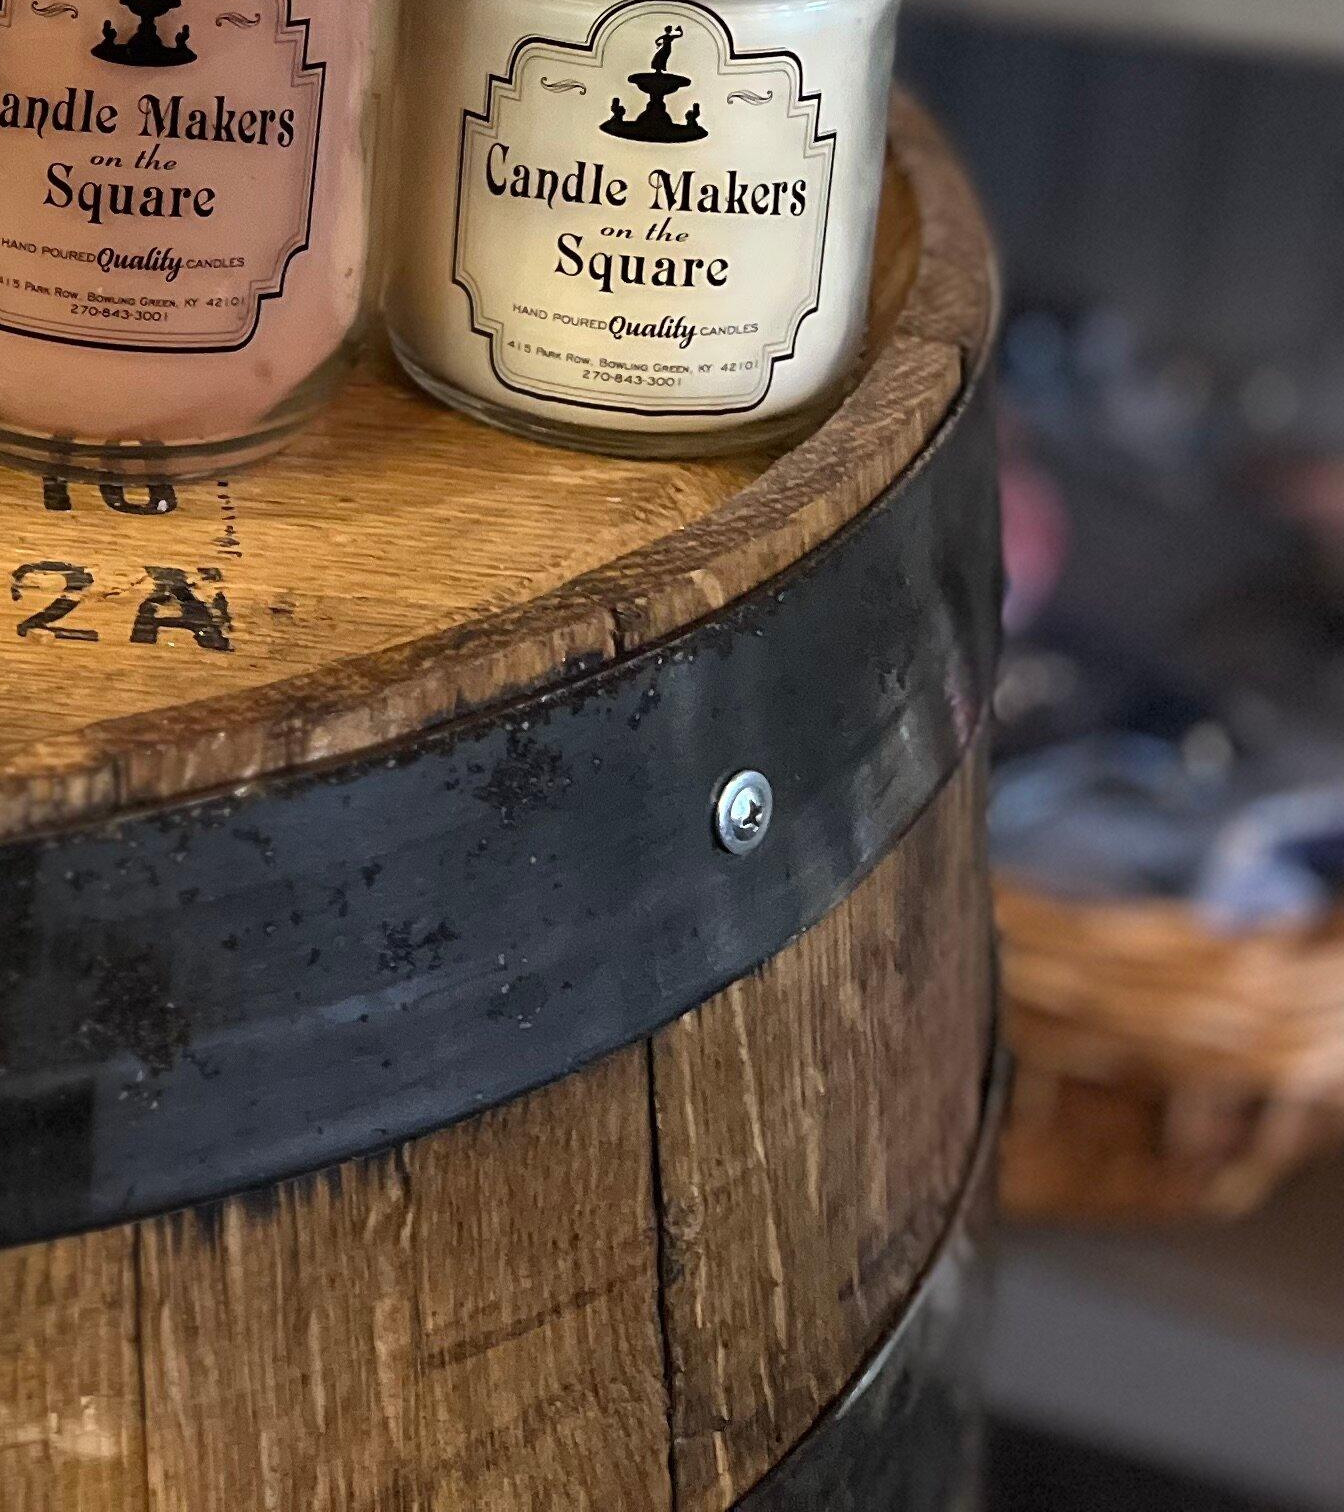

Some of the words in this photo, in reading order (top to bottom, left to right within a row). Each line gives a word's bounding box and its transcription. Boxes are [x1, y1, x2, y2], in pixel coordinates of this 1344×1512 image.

[138, 93, 296, 149] Makers
[90, 153, 123, 168] on
[135, 144, 178, 171] the
[485, 142, 629, 209] Candle
[648, 169, 807, 218] Makers
[43, 162, 217, 225] Square
[600, 225, 634, 239] on
[645, 217, 690, 243] the
[1, 237, 37, 254] HAND
[41, 245, 96, 263] POURED
[96, 246, 183, 282] Quality
[186, 257, 245, 269] CANDLES
[555, 232, 730, 294] Square
[70, 303, 169, 322] 270-843-3001
[512, 303, 548, 320] HAND
[552, 313, 608, 331] POURED
[608, 315, 698, 349] Quality
[700, 323, 760, 336] CANDLES
